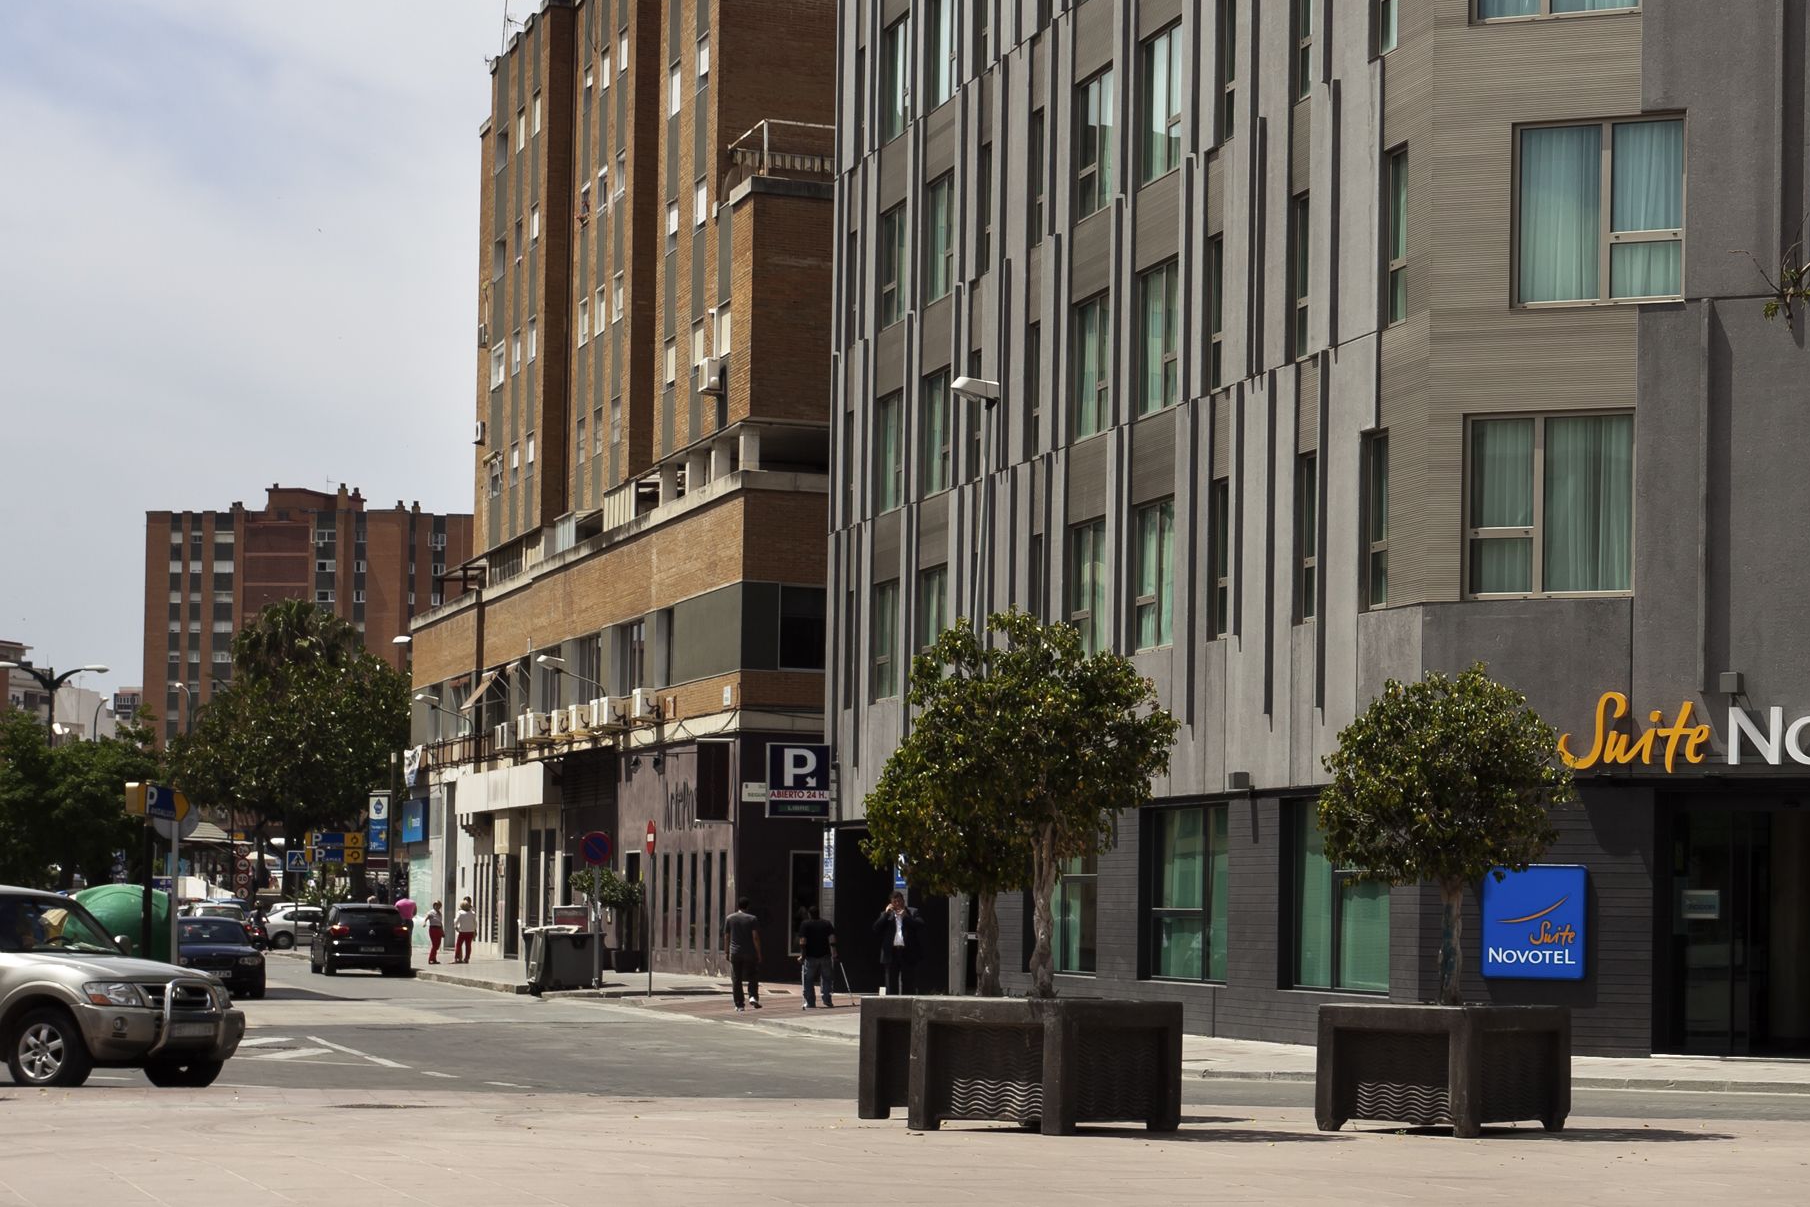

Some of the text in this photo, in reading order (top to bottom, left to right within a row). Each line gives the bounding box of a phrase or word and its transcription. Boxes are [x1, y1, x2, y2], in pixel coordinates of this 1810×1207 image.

[1556, 689, 1712, 774] Suite
[783, 747, 817, 787] P
[146, 786, 158, 815] P
[769, 790, 828, 800] ABIERTO 24 H.
[312, 833, 323, 847] P
[315, 849, 326, 862] P
[1529, 920, 1576, 947] Suite
[1488, 947, 1576, 964] NOVOTEL
